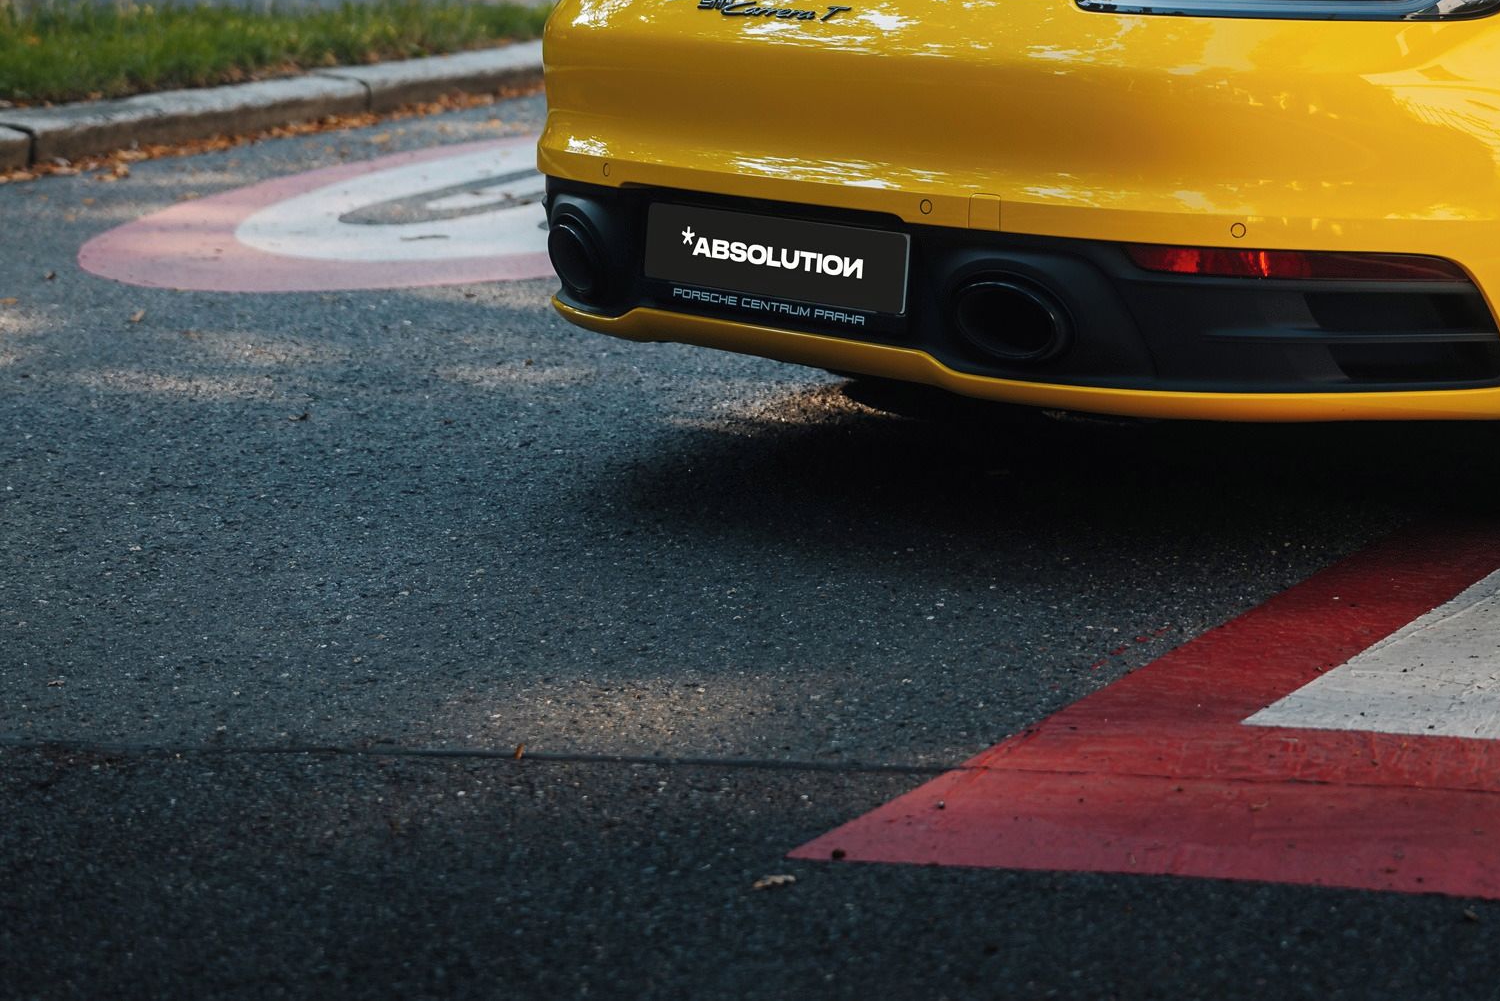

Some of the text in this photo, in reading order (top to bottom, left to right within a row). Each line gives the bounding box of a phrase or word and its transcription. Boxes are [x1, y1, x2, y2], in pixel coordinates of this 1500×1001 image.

[720, 1, 816, 20] Carrera
[820, 5, 852, 21] T
[672, 287, 866, 327] PORSCHE CENTRUM PRAHA
